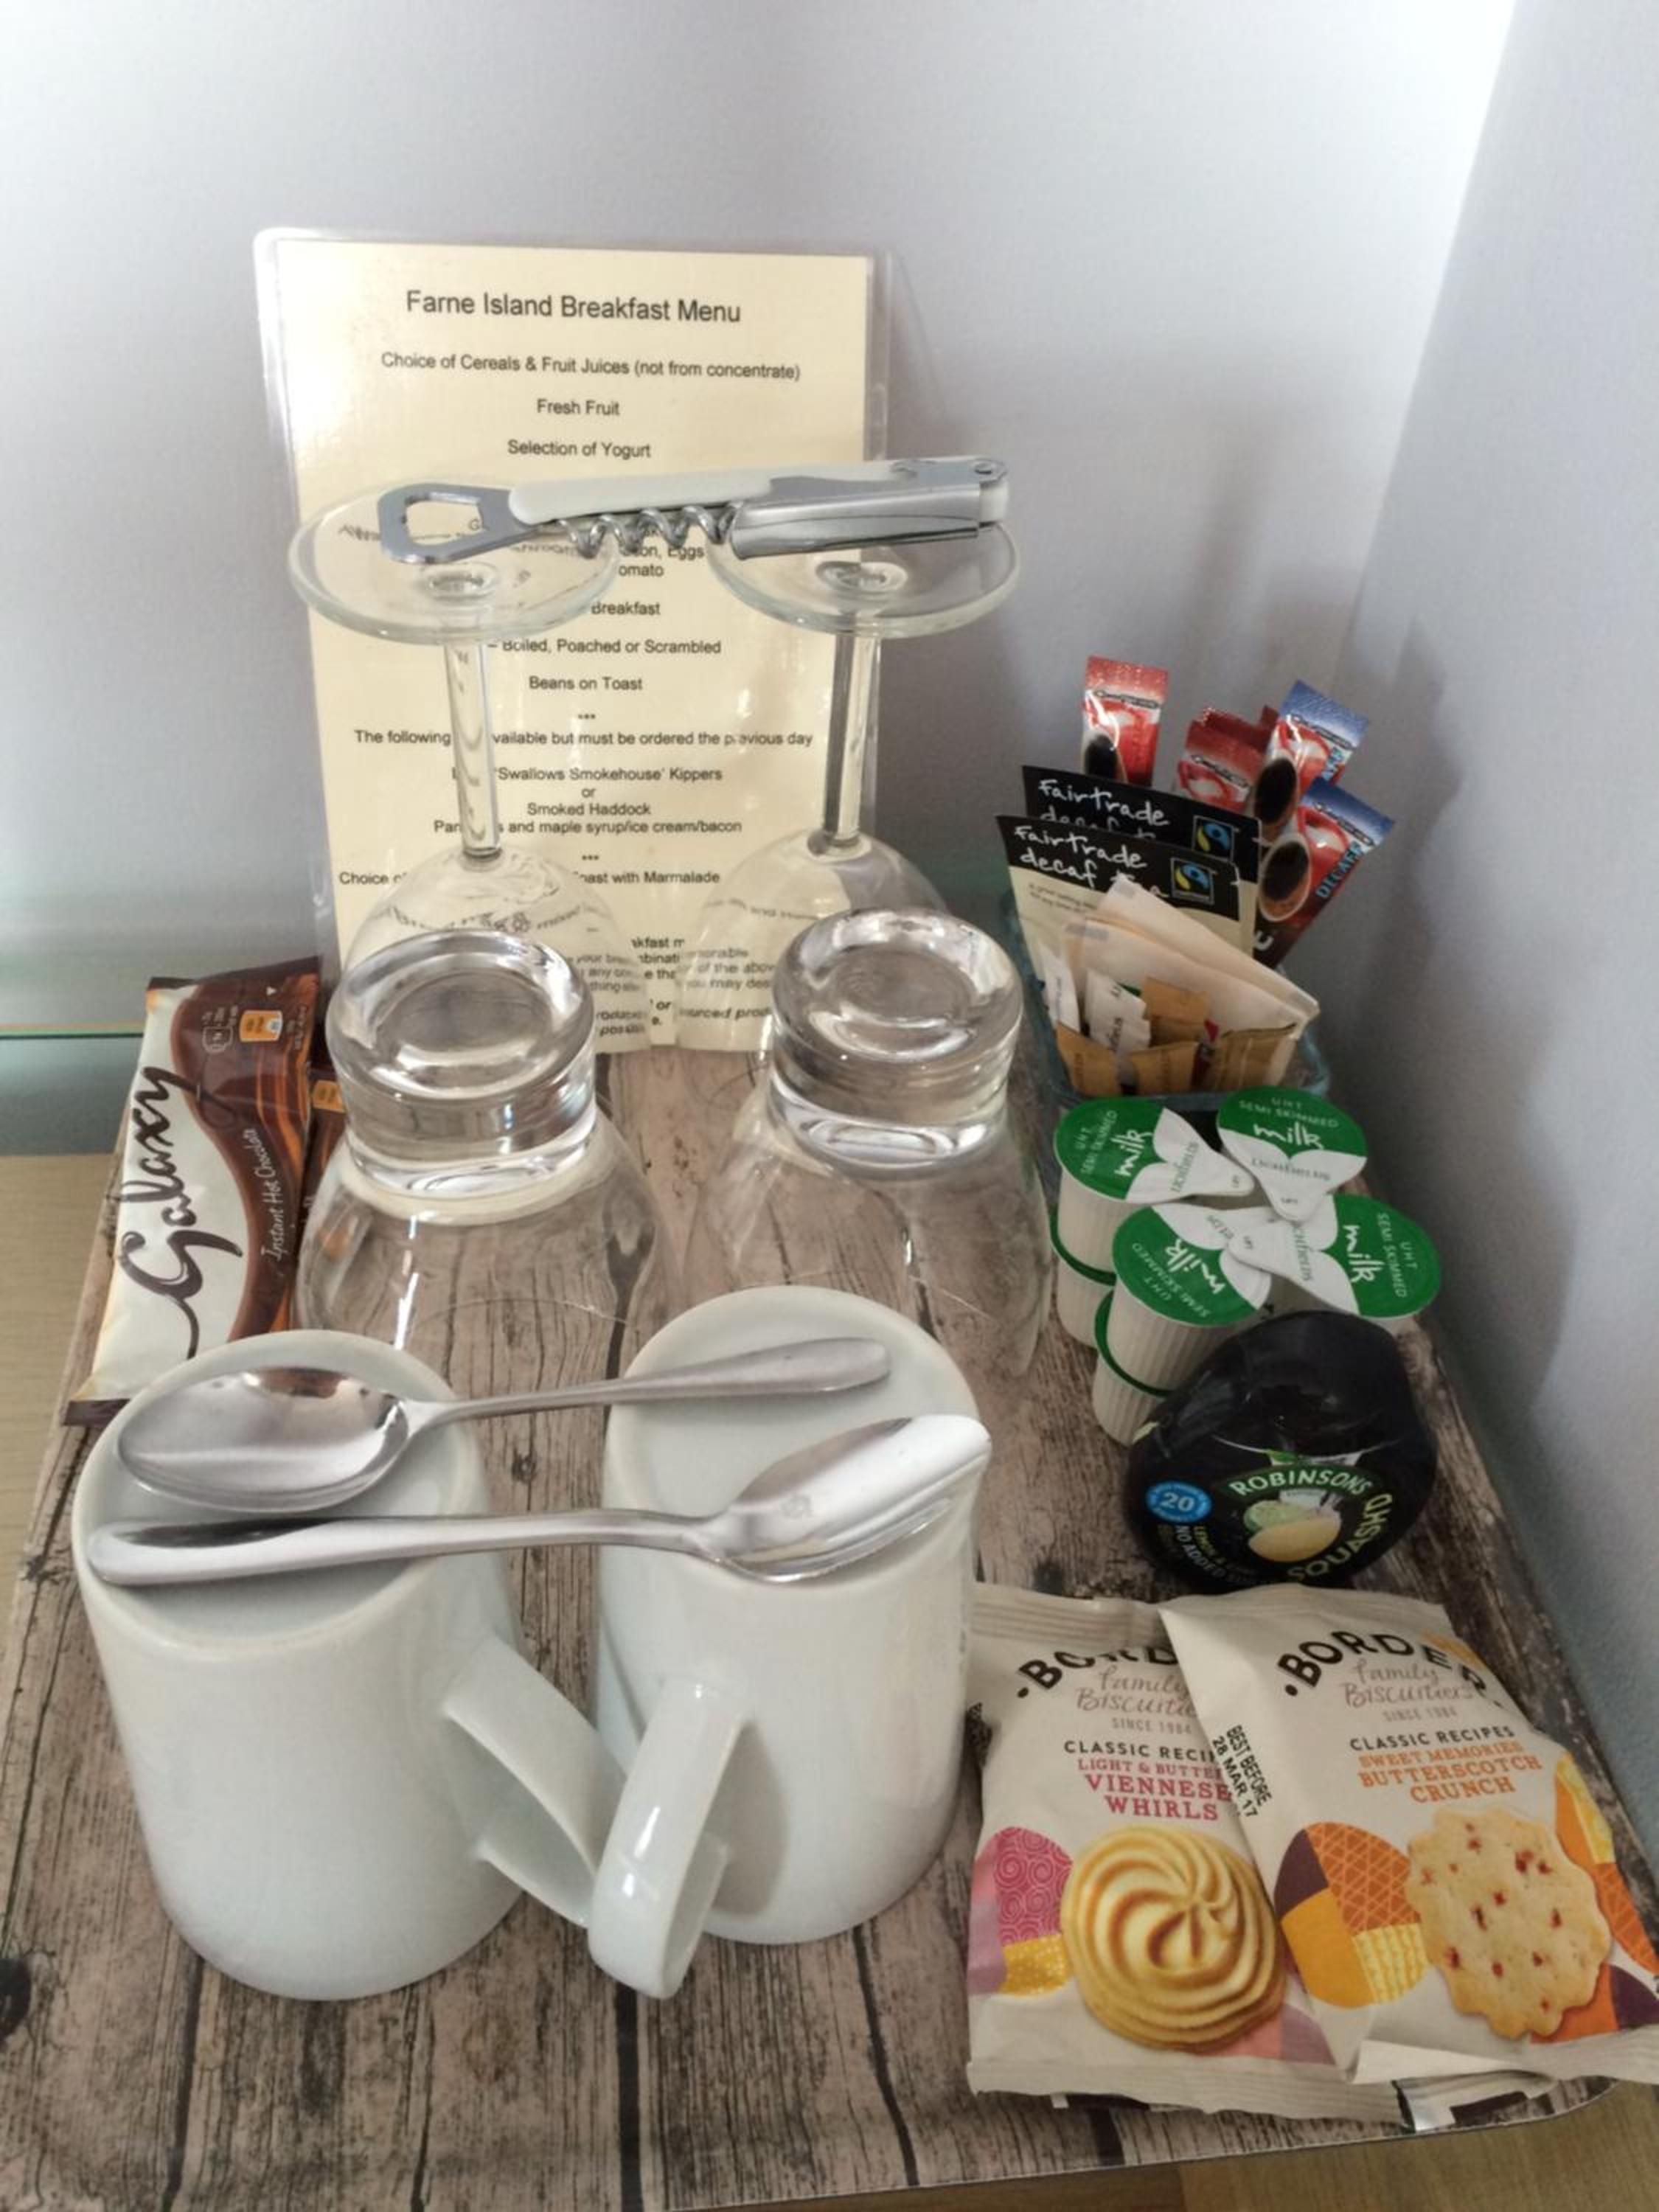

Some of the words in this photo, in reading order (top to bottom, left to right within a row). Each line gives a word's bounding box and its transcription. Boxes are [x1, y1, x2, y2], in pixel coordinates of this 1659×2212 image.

[407, 291, 476, 314] Farne
[484, 293, 552, 317] Island
[561, 295, 670, 321] Breakfast
[678, 299, 741, 322] Menu
[381, 352, 437, 369] Choice
[440, 353, 456, 369] of
[460, 354, 521, 372] Cereals
[525, 356, 537, 371] &
[542, 357, 577, 373] Fruit
[581, 358, 630, 375] Juices
[634, 359, 665, 378] (not
[668, 360, 702, 377] from
[706, 362, 801, 381] concentrate)
[537, 399, 580, 415] Fresh
[585, 399, 620, 416] Fruit
[507, 439, 578, 456] Selection
[582, 440, 597, 456] of
[601, 442, 651, 459] Yogurt
[619, 565, 664, 577] omato
[557, 638, 622, 653] Poached
[625, 641, 639, 653] or
[644, 639, 721, 654] Scrambled
[529, 675, 575, 690] Beans
[579, 679, 597, 690] on
[602, 676, 643, 691] Toast
[355, 730, 383, 743] The
[387, 730, 451, 746] following
[492, 732, 547, 744] vailable
[552, 732, 574, 745] but
[579, 733, 613, 745] must
[617, 733, 635, 745] be
[639, 733, 694, 745] ordered
[698, 733, 720, 745] the
[787, 733, 813, 747] day
[669, 768, 723, 782] Kippers
[581, 788, 596, 799] or
[1038, 779, 1170, 826] Fairtrade
[526, 802, 585, 815] Smoked
[589, 803, 651, 815] Haddock
[508, 821, 534, 833] and
[539, 821, 582, 835] maple
[1014, 826, 1147, 869] Fairtrade
[339, 872, 389, 885] Choice
[611, 872, 639, 883] with
[644, 872, 720, 883] Marmalade
[1020, 847, 1098, 889] decaf
[1253, 1121, 1325, 1150] milk
[1112, 1129, 1152, 1177] milk
[260, 1180, 284, 1203] Hot
[119, 1066, 243, 1360] Galaxy
[260, 1206, 288, 1263] Instant
[1165, 1238, 1227, 1295] milk
[1342, 1225, 1385, 1284] milk
[1400, 1242, 1419, 1269] UHT
[1229, 1470, 1375, 1497] ROBINSONS
[1160, 1491, 1195, 1513] 20
[1354, 1658, 1441, 1684] Family
[1112, 1717, 1151, 1732] SINCE
[1382, 1708, 1422, 1722] SINCE
[1064, 1739, 1150, 1757] CLASSIC
[1227, 1724, 1252, 1756] BEST
[1350, 1733, 1430, 1751] CLASSIC
[1437, 1725, 1515, 1745] RECIPES
[1077, 1757, 1132, 1773] LIGHT
[1138, 1761, 1151, 1774] &
[1358, 1750, 1425, 1769] SWEET
[1427, 1741, 1524, 1763] MEMORIES
[1212, 1735, 1228, 1756] 28
[1223, 1756, 1248, 1798] MAR
[1242, 1799, 1259, 1818] 17
[1239, 1754, 1273, 1807] BEFORE
[1357, 1754, 1543, 1788] BUTTERSCOTCH
[1084, 1773, 1234, 1803] VIENNESE
[1409, 1775, 1517, 1804] CRUNCH
[1104, 1794, 1219, 1821] WHIRLS
